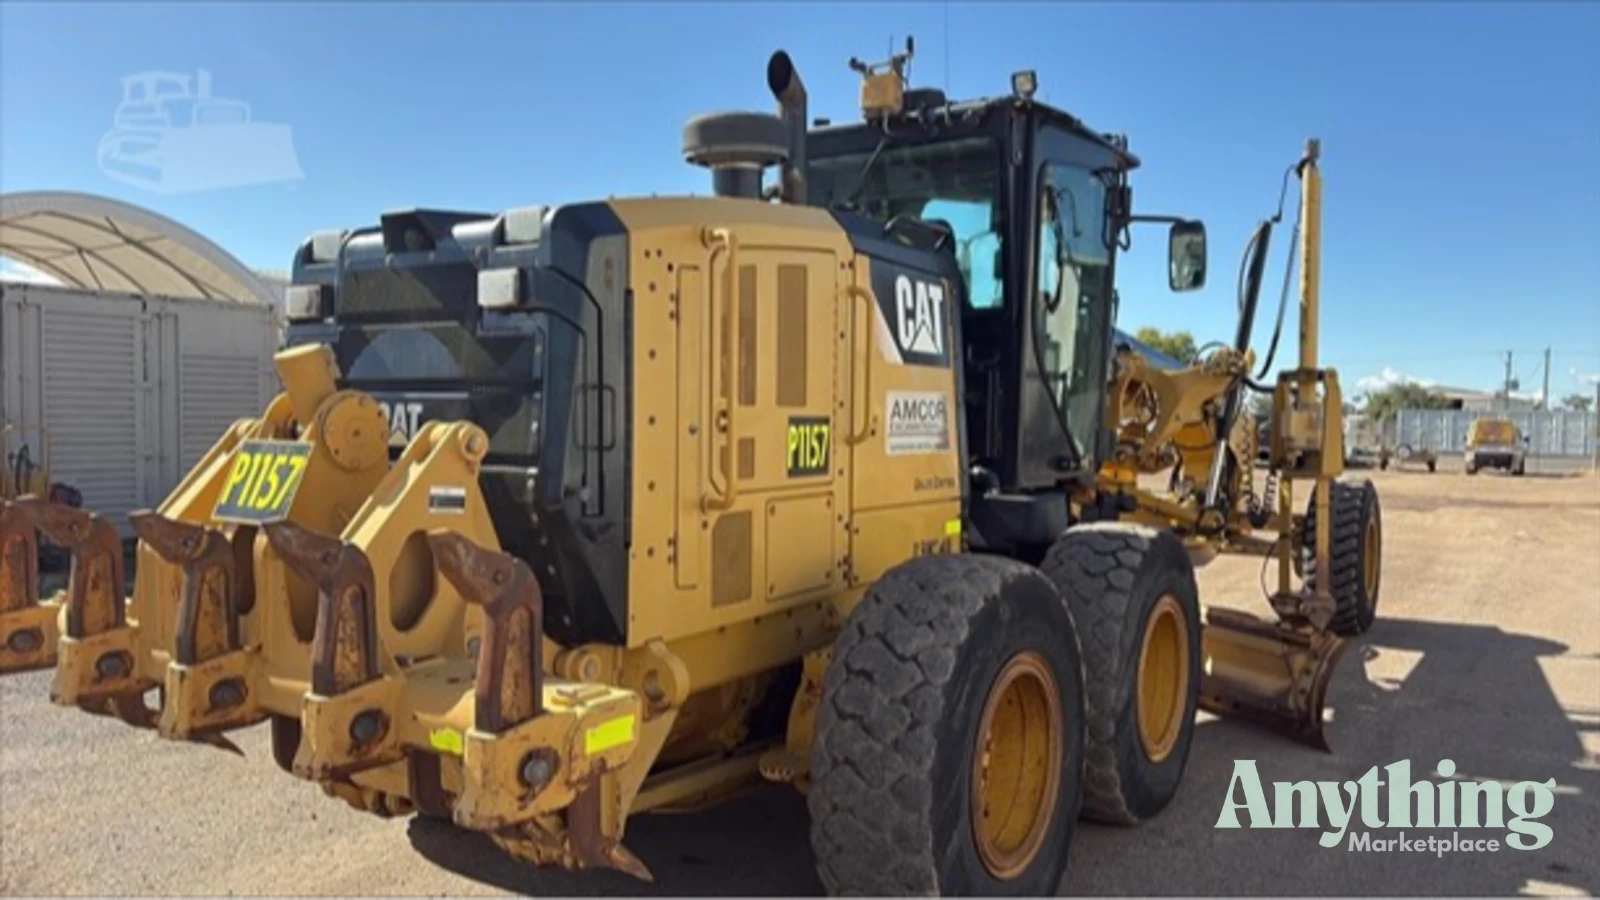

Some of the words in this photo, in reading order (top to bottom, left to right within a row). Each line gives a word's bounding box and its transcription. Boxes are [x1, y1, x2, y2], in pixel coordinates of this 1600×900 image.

[895, 275, 943, 355] CAT
[787, 424, 829, 469] P1157
[220, 453, 304, 510] P1157
